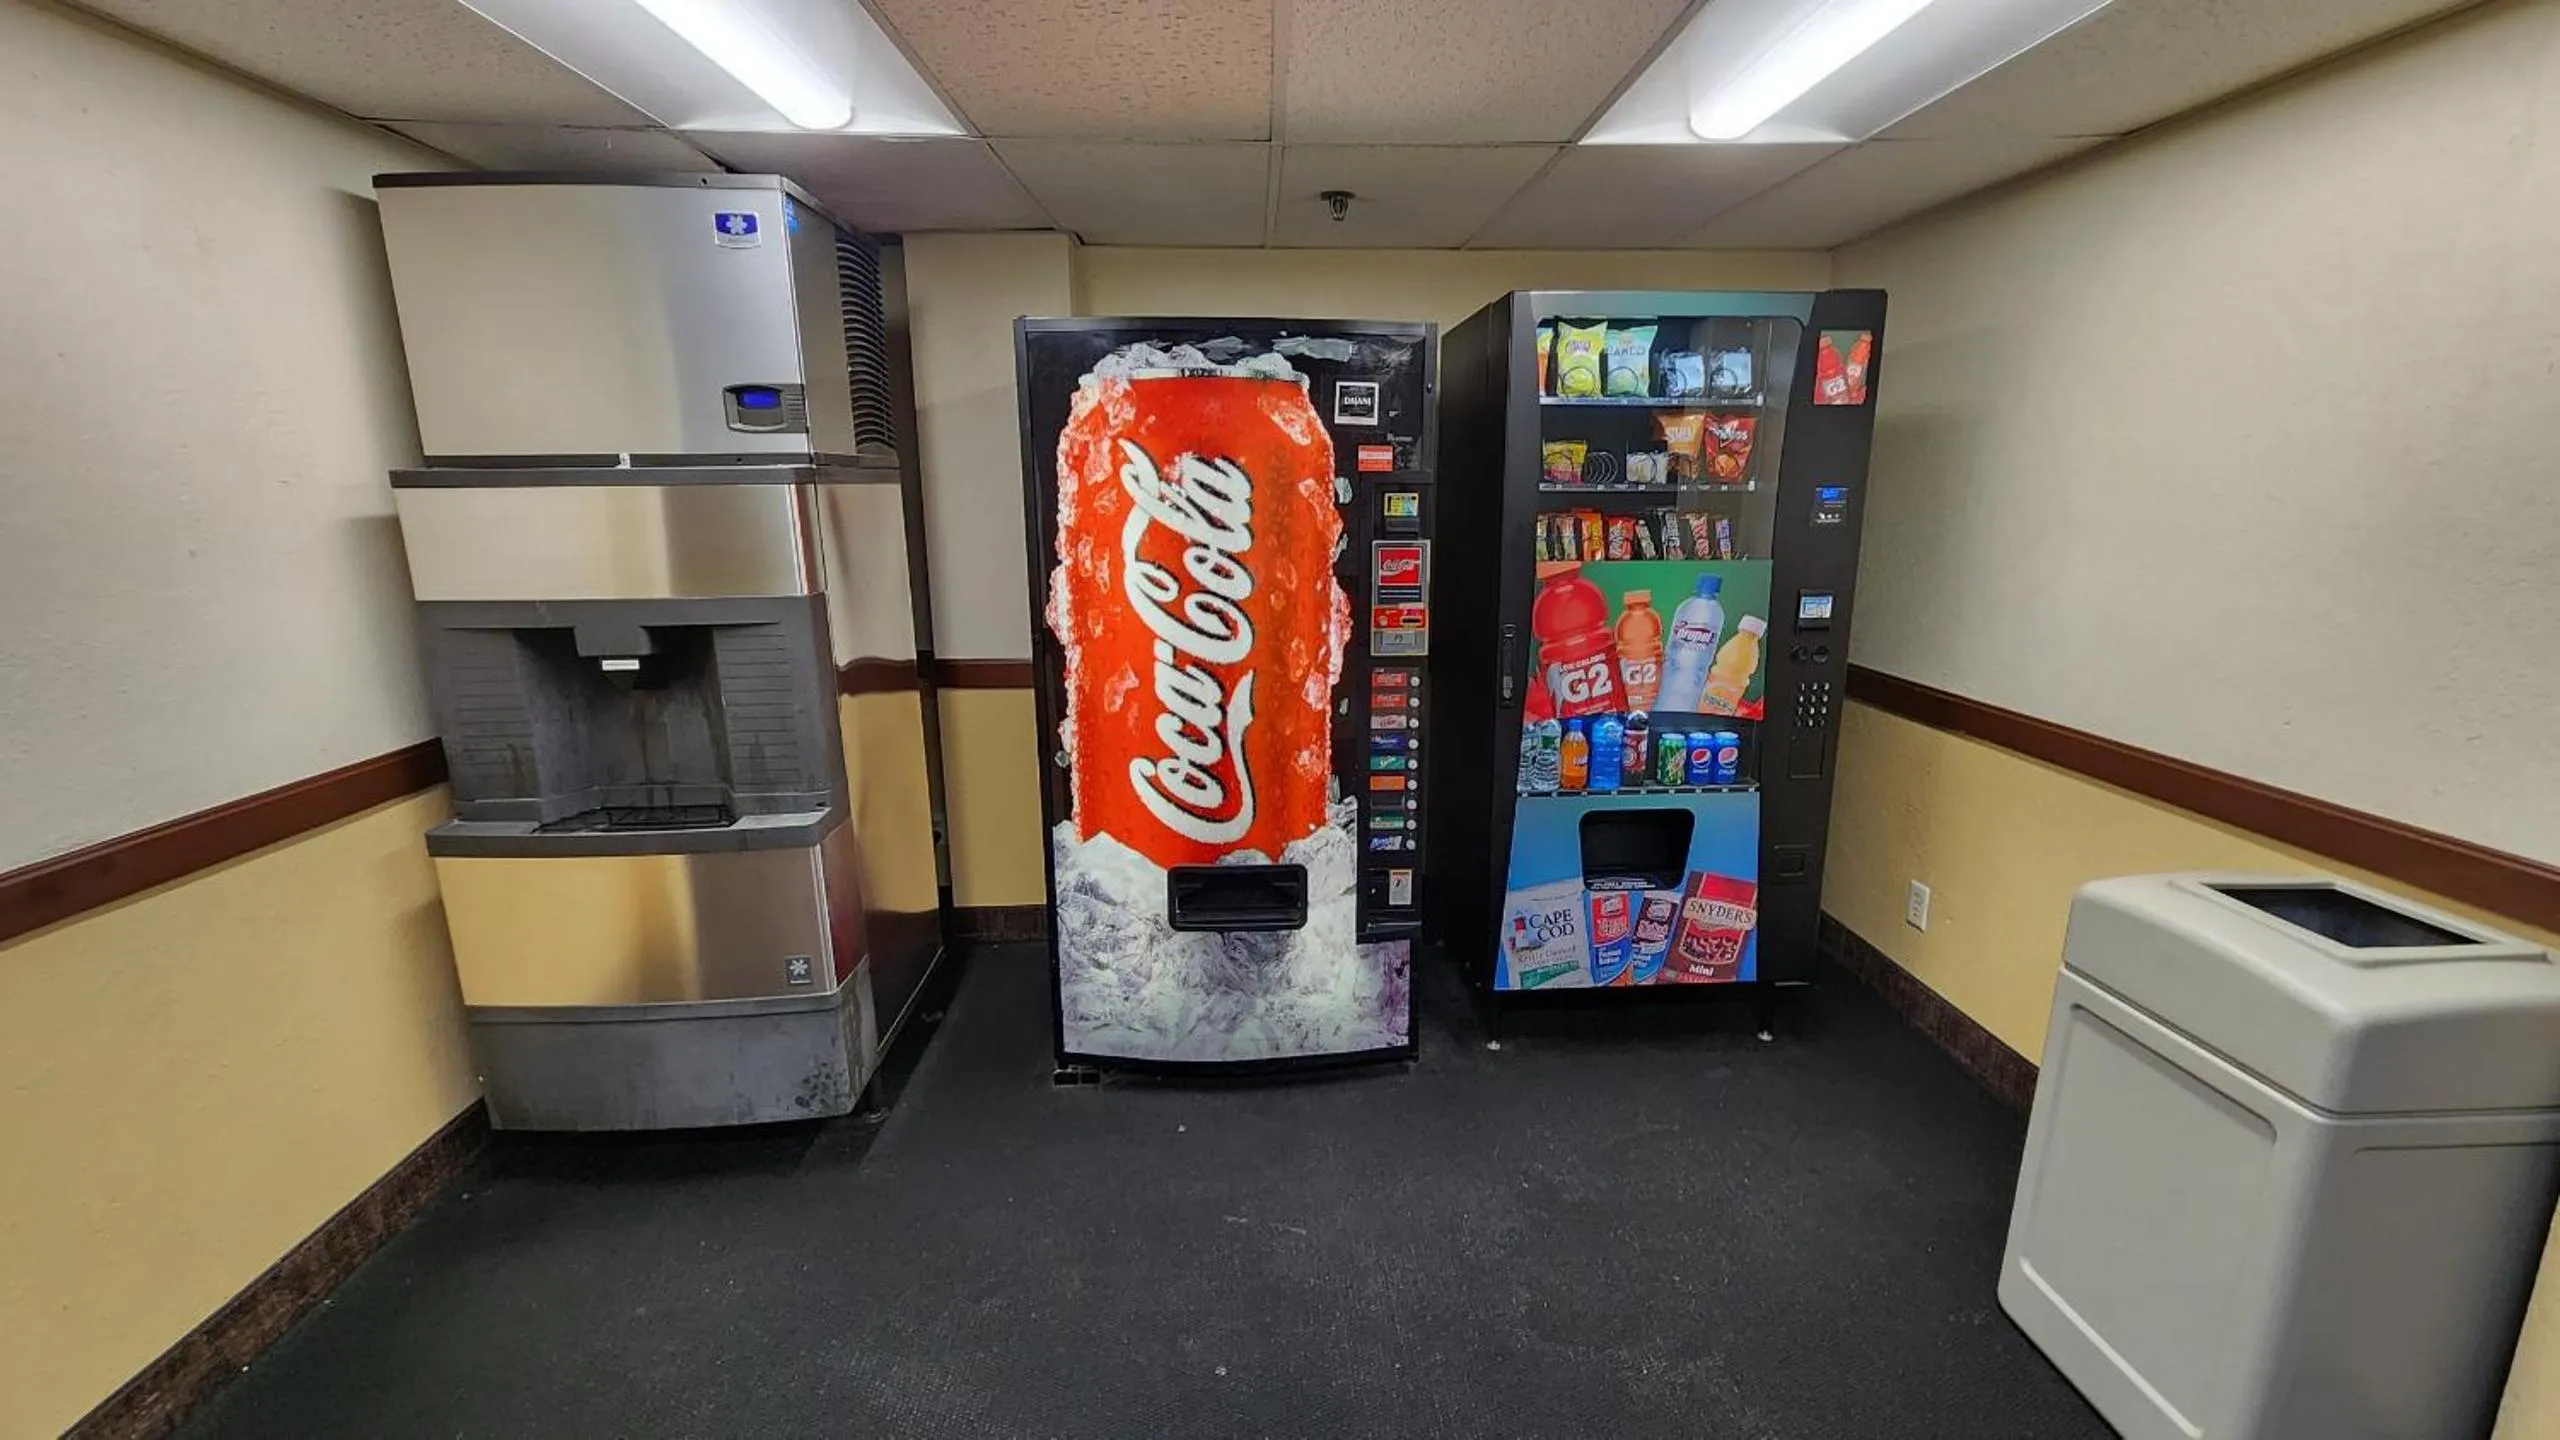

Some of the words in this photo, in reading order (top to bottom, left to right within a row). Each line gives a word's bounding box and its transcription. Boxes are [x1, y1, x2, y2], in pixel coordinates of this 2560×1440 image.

[1561, 662, 1613, 703] G2
[1626, 663, 1657, 685] G2
[1529, 908, 1574, 929] CAPE
[1537, 922, 1575, 942] COD
[1689, 963, 1715, 977] Mini
